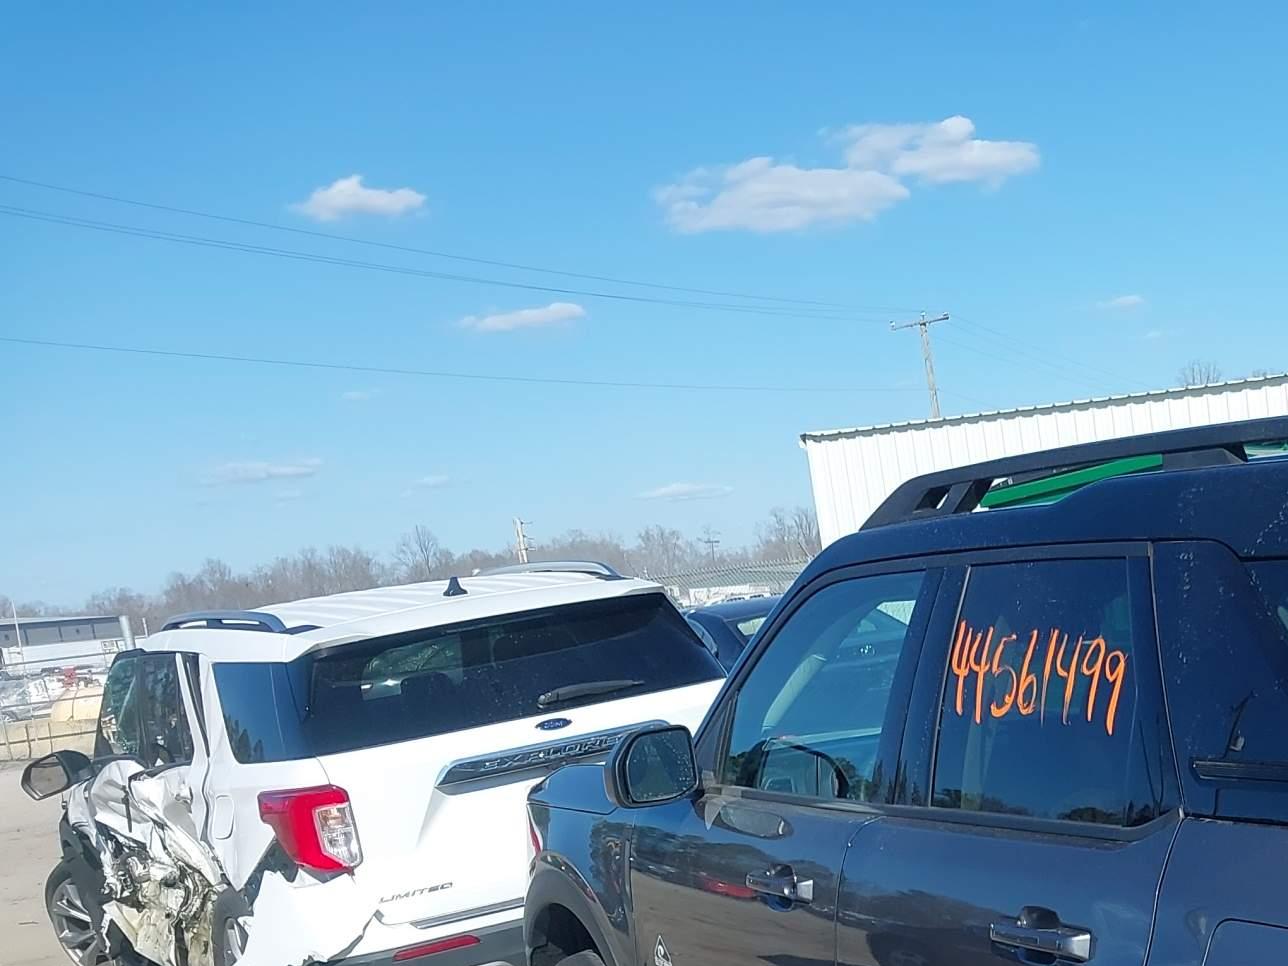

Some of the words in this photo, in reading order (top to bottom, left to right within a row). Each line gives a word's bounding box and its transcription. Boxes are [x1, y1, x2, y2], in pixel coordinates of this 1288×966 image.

[951, 619, 1128, 736] 44561499
[480, 735, 622, 772] EXPLORE
[379, 881, 453, 904] LIMITED
